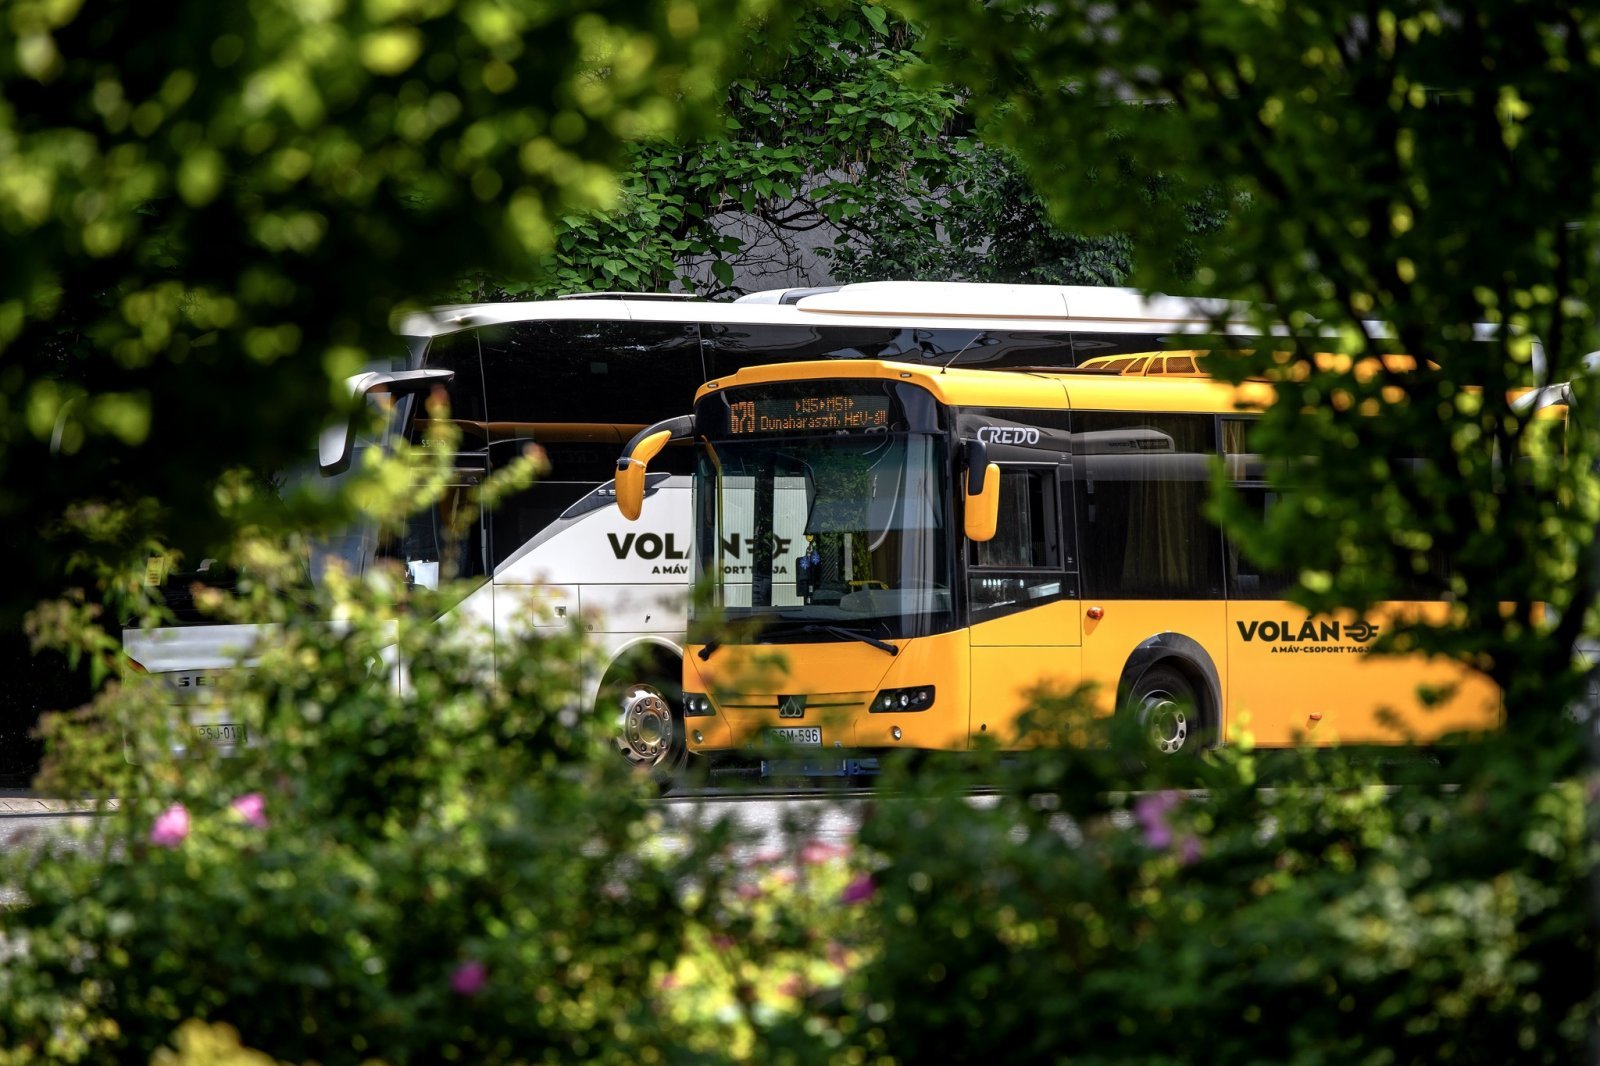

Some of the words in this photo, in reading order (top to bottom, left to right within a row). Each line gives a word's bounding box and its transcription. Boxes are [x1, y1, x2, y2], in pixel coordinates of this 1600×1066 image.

[977, 426, 1040, 445] CREDO
[607, 532, 740, 560] VOLN
[652, 566, 660, 574] A
[1236, 616, 1340, 642] VOLÁN
[1280, 645, 1345, 654] MÁV-CSOPORT
